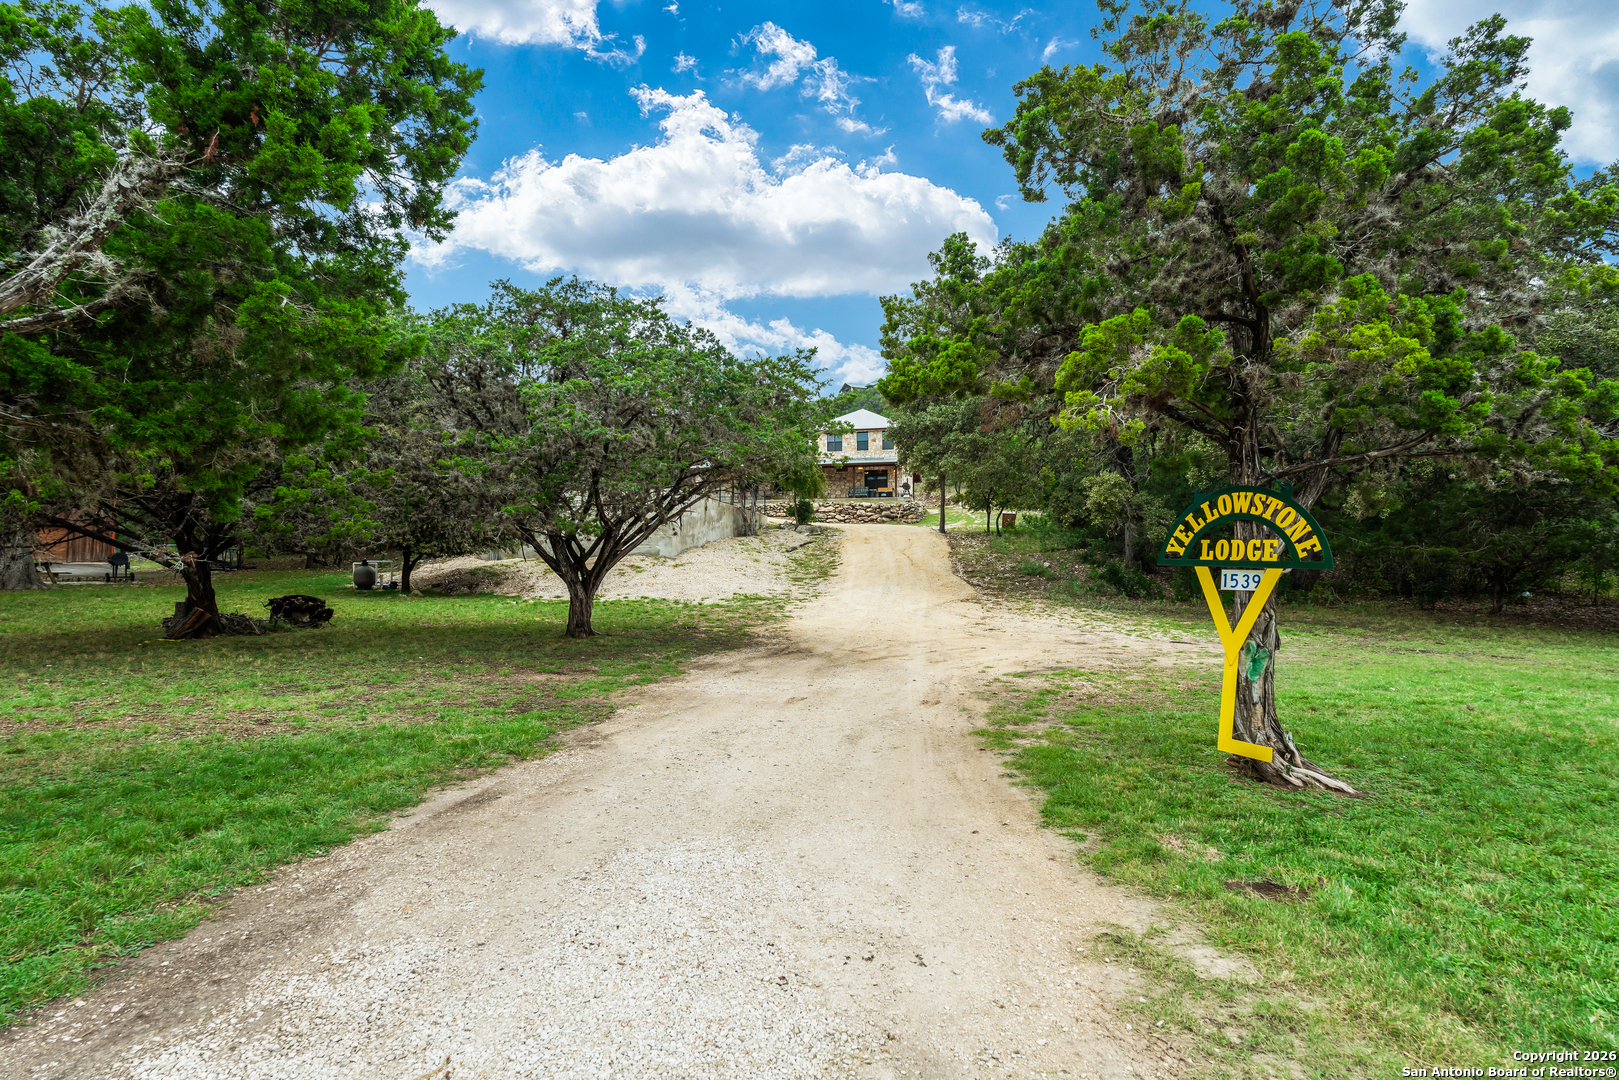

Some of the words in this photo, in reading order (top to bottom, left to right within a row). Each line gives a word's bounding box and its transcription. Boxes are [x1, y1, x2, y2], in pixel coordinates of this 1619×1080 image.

[1166, 491, 1322, 559] YELLOWSTONE
[1200, 539, 1278, 561] LODGE
[1223, 573, 1262, 589] 1539
